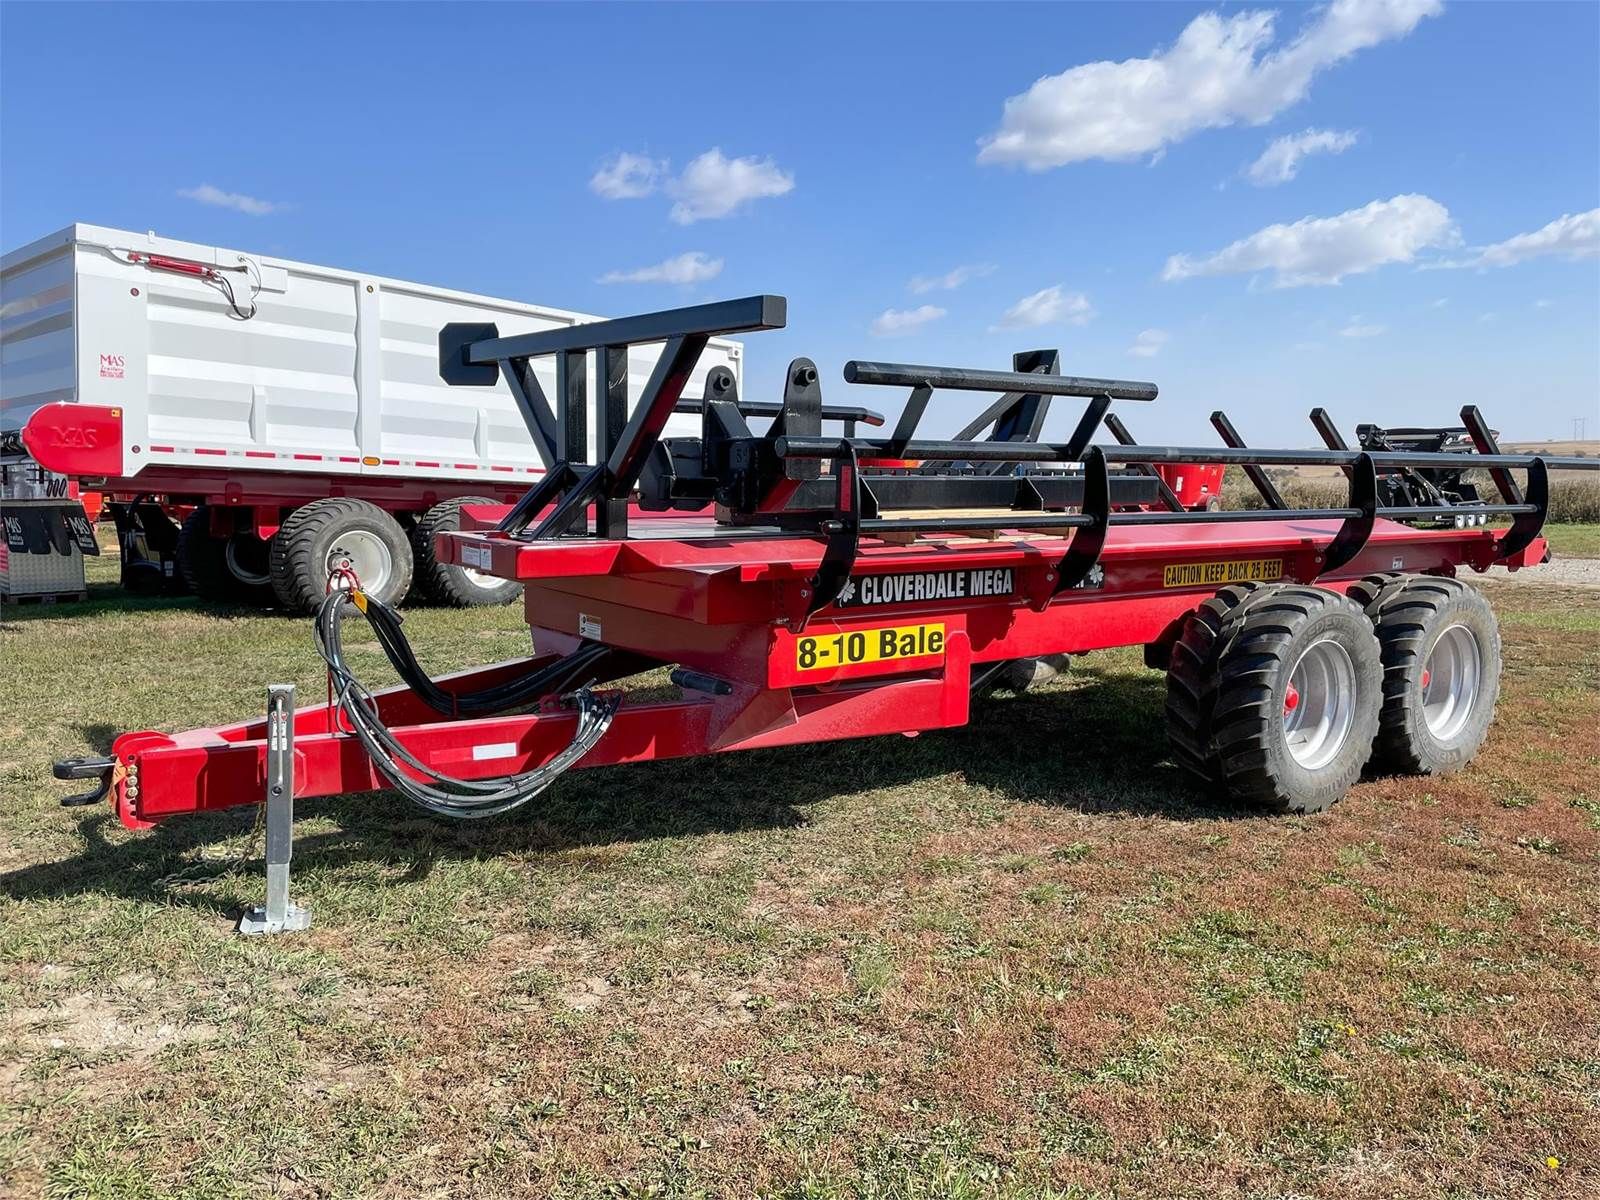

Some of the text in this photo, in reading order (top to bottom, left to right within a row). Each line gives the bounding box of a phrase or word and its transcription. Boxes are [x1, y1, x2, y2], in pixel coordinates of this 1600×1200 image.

[100, 354, 125, 367] MAS
[49, 426, 98, 448] MAS
[4, 516, 22, 533] MAS
[68, 517, 90, 534] MAS
[1166, 560, 1281, 585] CAUTION KEEP BACK 25 FEET
[861, 569, 1013, 604] CLOVERDALE MEGA
[798, 626, 943, 668] 8-10 Bale
